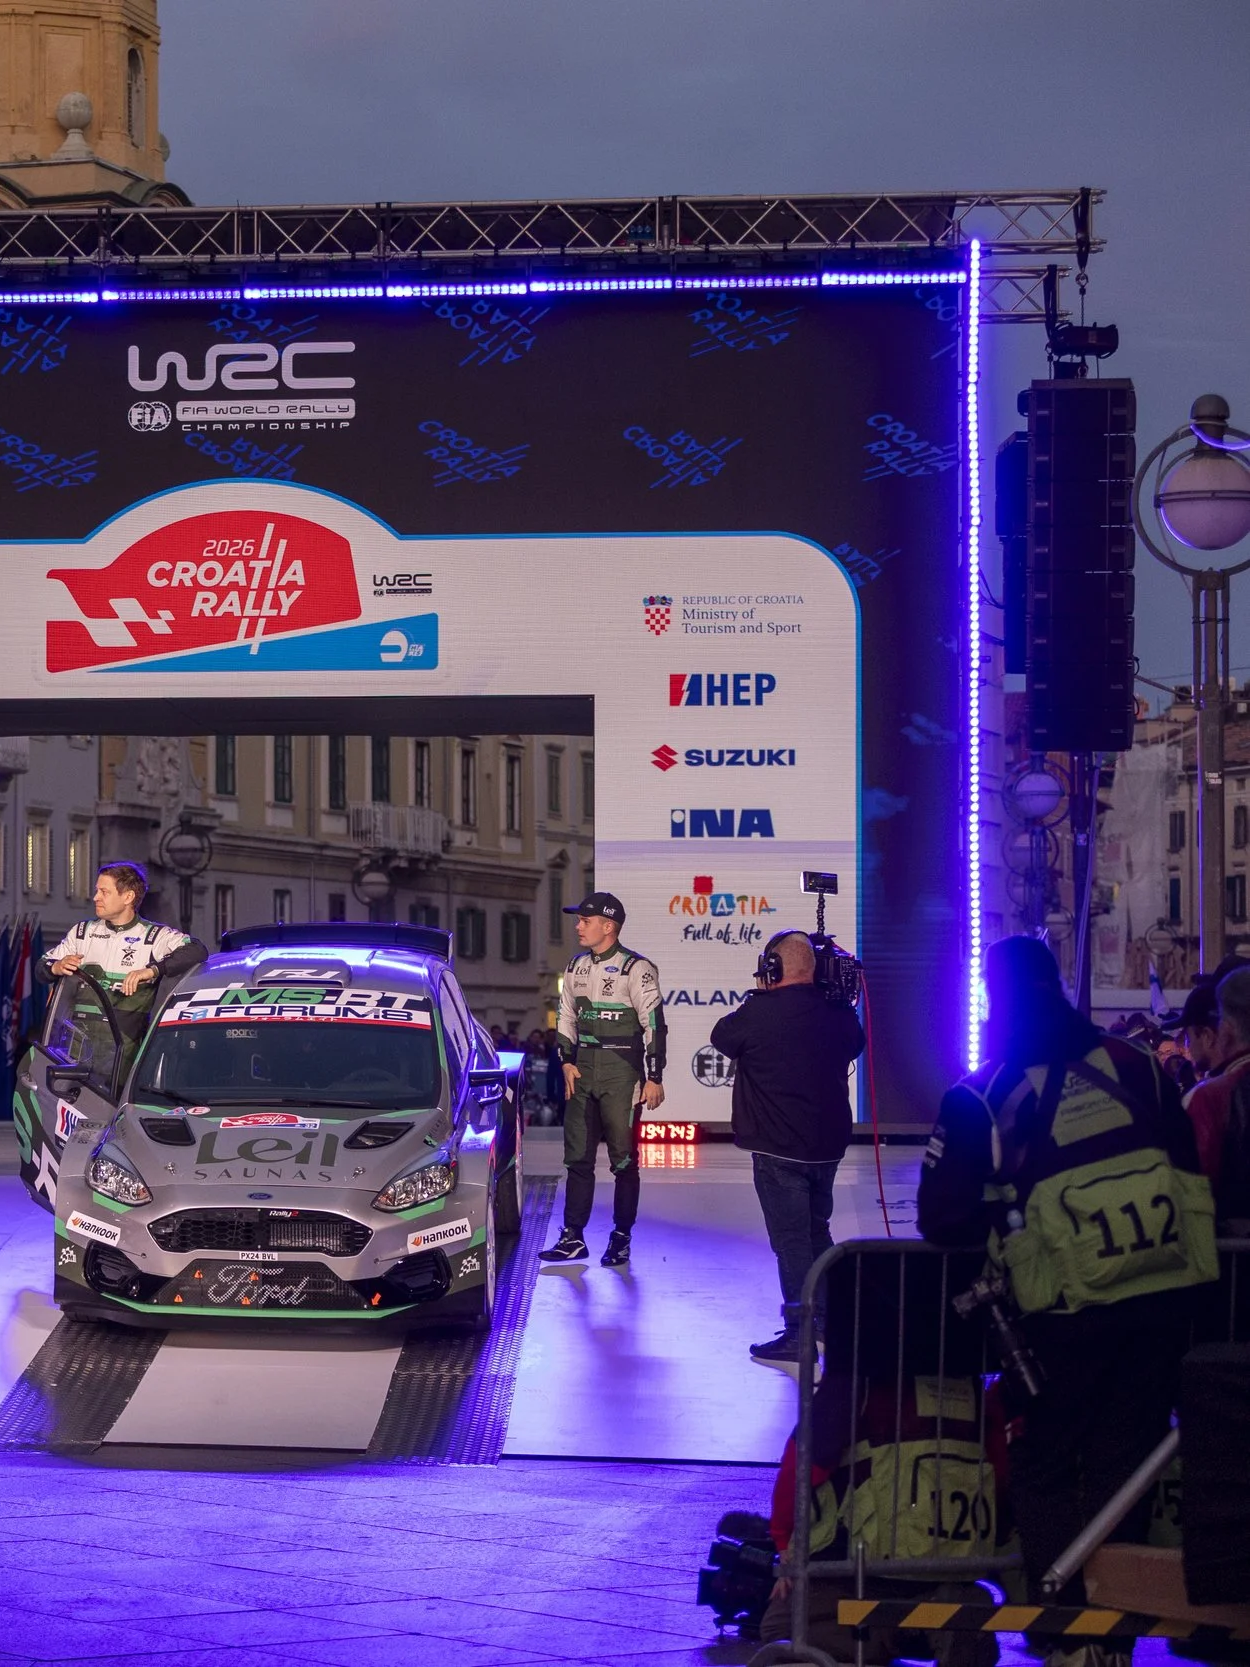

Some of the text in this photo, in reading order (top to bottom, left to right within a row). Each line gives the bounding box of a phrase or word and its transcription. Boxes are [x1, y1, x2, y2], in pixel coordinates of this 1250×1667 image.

[128, 341, 356, 392] WRC
[182, 407, 208, 416] FIA
[215, 406, 280, 415] WORLD
[286, 405, 350, 414] RALLY
[182, 422, 350, 431] CHAMPIONSHIP
[202, 540, 255, 557] 2026
[147, 559, 306, 589] CROATIA
[373, 573, 432, 586] WRC
[191, 591, 302, 617] RALLY
[682, 596, 804, 605] REPUBLIC OF CROATIA
[682, 608, 756, 621] Ministry of
[682, 622, 802, 635] Tourism and Sport
[706, 673, 777, 706] HEP
[684, 748, 796, 767] SUZUKI
[669, 893, 777, 917] CROATIA
[214, 1005, 415, 1022] FORUM8
[196, 1131, 339, 1167] Leil
[194, 1167, 332, 1183] SAUNAS
[269, 1210, 299, 1218] Rally2
[1089, 1195, 1181, 1259] 112
[240, 1252, 259, 1260] PX24
